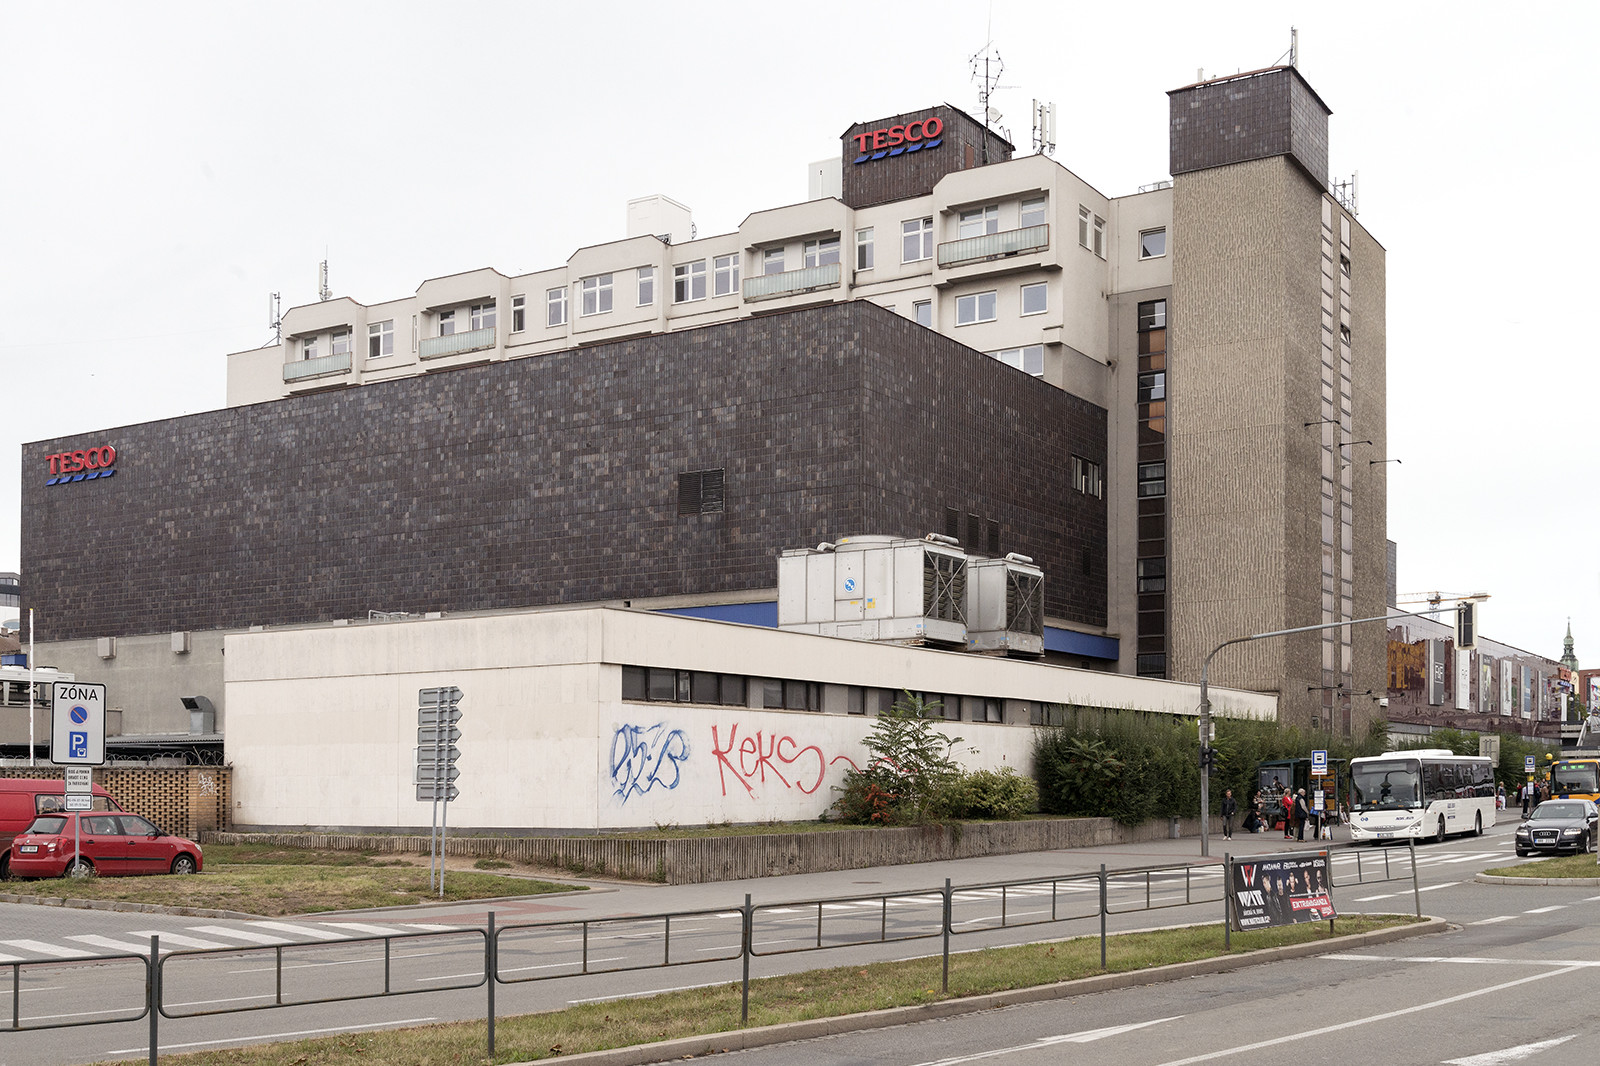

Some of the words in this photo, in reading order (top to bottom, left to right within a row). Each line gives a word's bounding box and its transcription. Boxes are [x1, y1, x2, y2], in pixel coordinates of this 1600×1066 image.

[853, 116, 943, 152] TESCO
[45, 445, 116, 475] TESCO
[60, 685, 98, 701] ZÓNA
